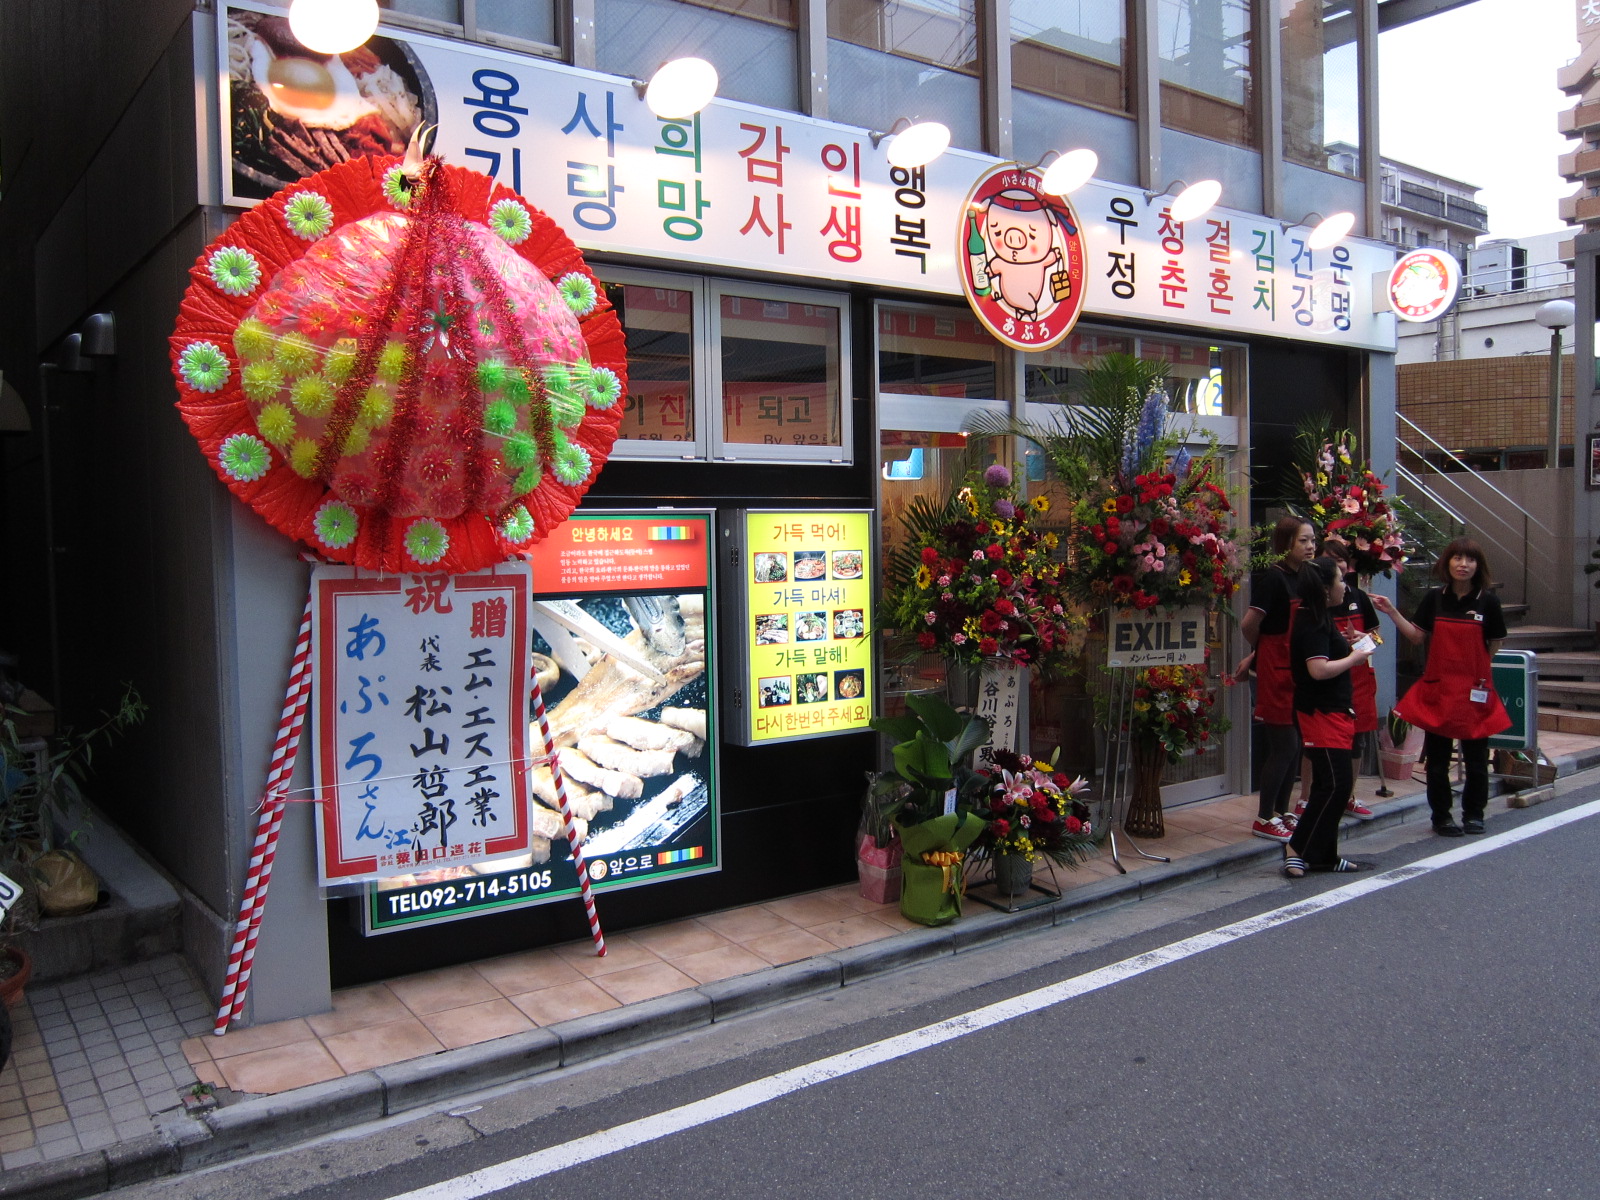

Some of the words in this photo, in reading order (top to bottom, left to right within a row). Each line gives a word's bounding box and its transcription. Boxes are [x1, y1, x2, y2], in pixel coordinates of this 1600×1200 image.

[561, 90, 624, 231] 사랑
[654, 111, 711, 241] 희망
[738, 122, 792, 255] 감사
[820, 142, 862, 263] 인생
[887, 160, 931, 275] 행복
[1069, 241, 1080, 280] 앞으로
[1106, 197, 1138, 299] 우정
[1157, 207, 1188, 309] 청춘
[1205, 219, 1233, 315] 결혼
[1251, 229, 1275, 322] 김치
[1290, 238, 1317, 327] 건강
[1330, 245, 1353, 331] 운명
[1002, 318, 1050, 341] あぷろ
[758, 395, 812, 427] 되고
[572, 526, 634, 542] 안녕하세요
[773, 523, 805, 542] 가득
[811, 522, 846, 541] 먹어!
[404, 573, 453, 615] 祝
[773, 588, 805, 607] 가득
[811, 587, 846, 606] 마셔!
[470, 596, 508, 639] 贈
[1115, 621, 1197, 652] EXILE
[419, 634, 443, 672] 代表
[775, 648, 807, 668] 가득
[813, 645, 848, 665] 말해!
[609, 854, 654, 876] 앞으로
